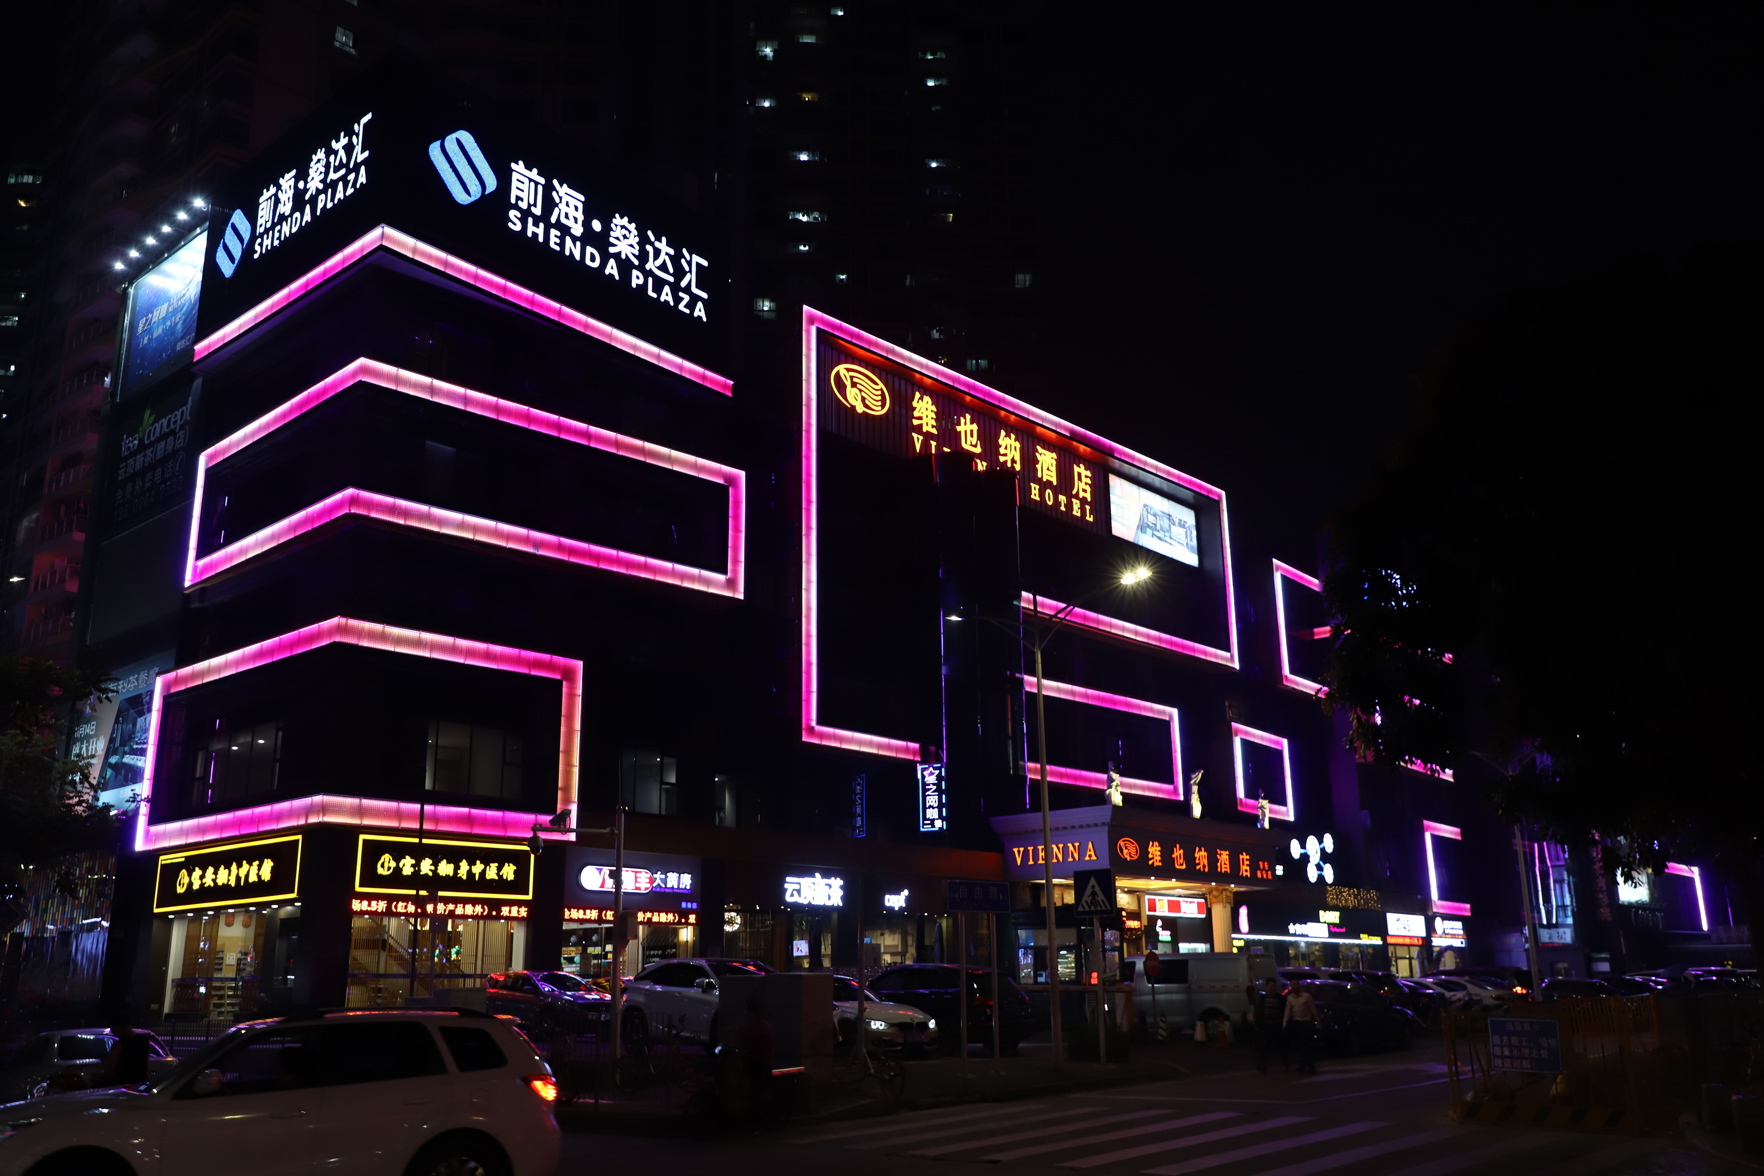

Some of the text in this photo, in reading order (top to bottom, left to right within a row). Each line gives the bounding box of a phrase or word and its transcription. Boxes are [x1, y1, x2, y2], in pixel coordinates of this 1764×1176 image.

[253, 165, 367, 259] SHENDA PLAZA
[507, 209, 707, 322] SHENDA PLAZA
[144, 396, 192, 444] concept
[912, 391, 1092, 501] 维也纳酒店
[1030, 482, 1093, 522] HOTEL
[1013, 841, 1097, 866] VIENNA
[1148, 841, 1251, 877] 维也纳酒店
